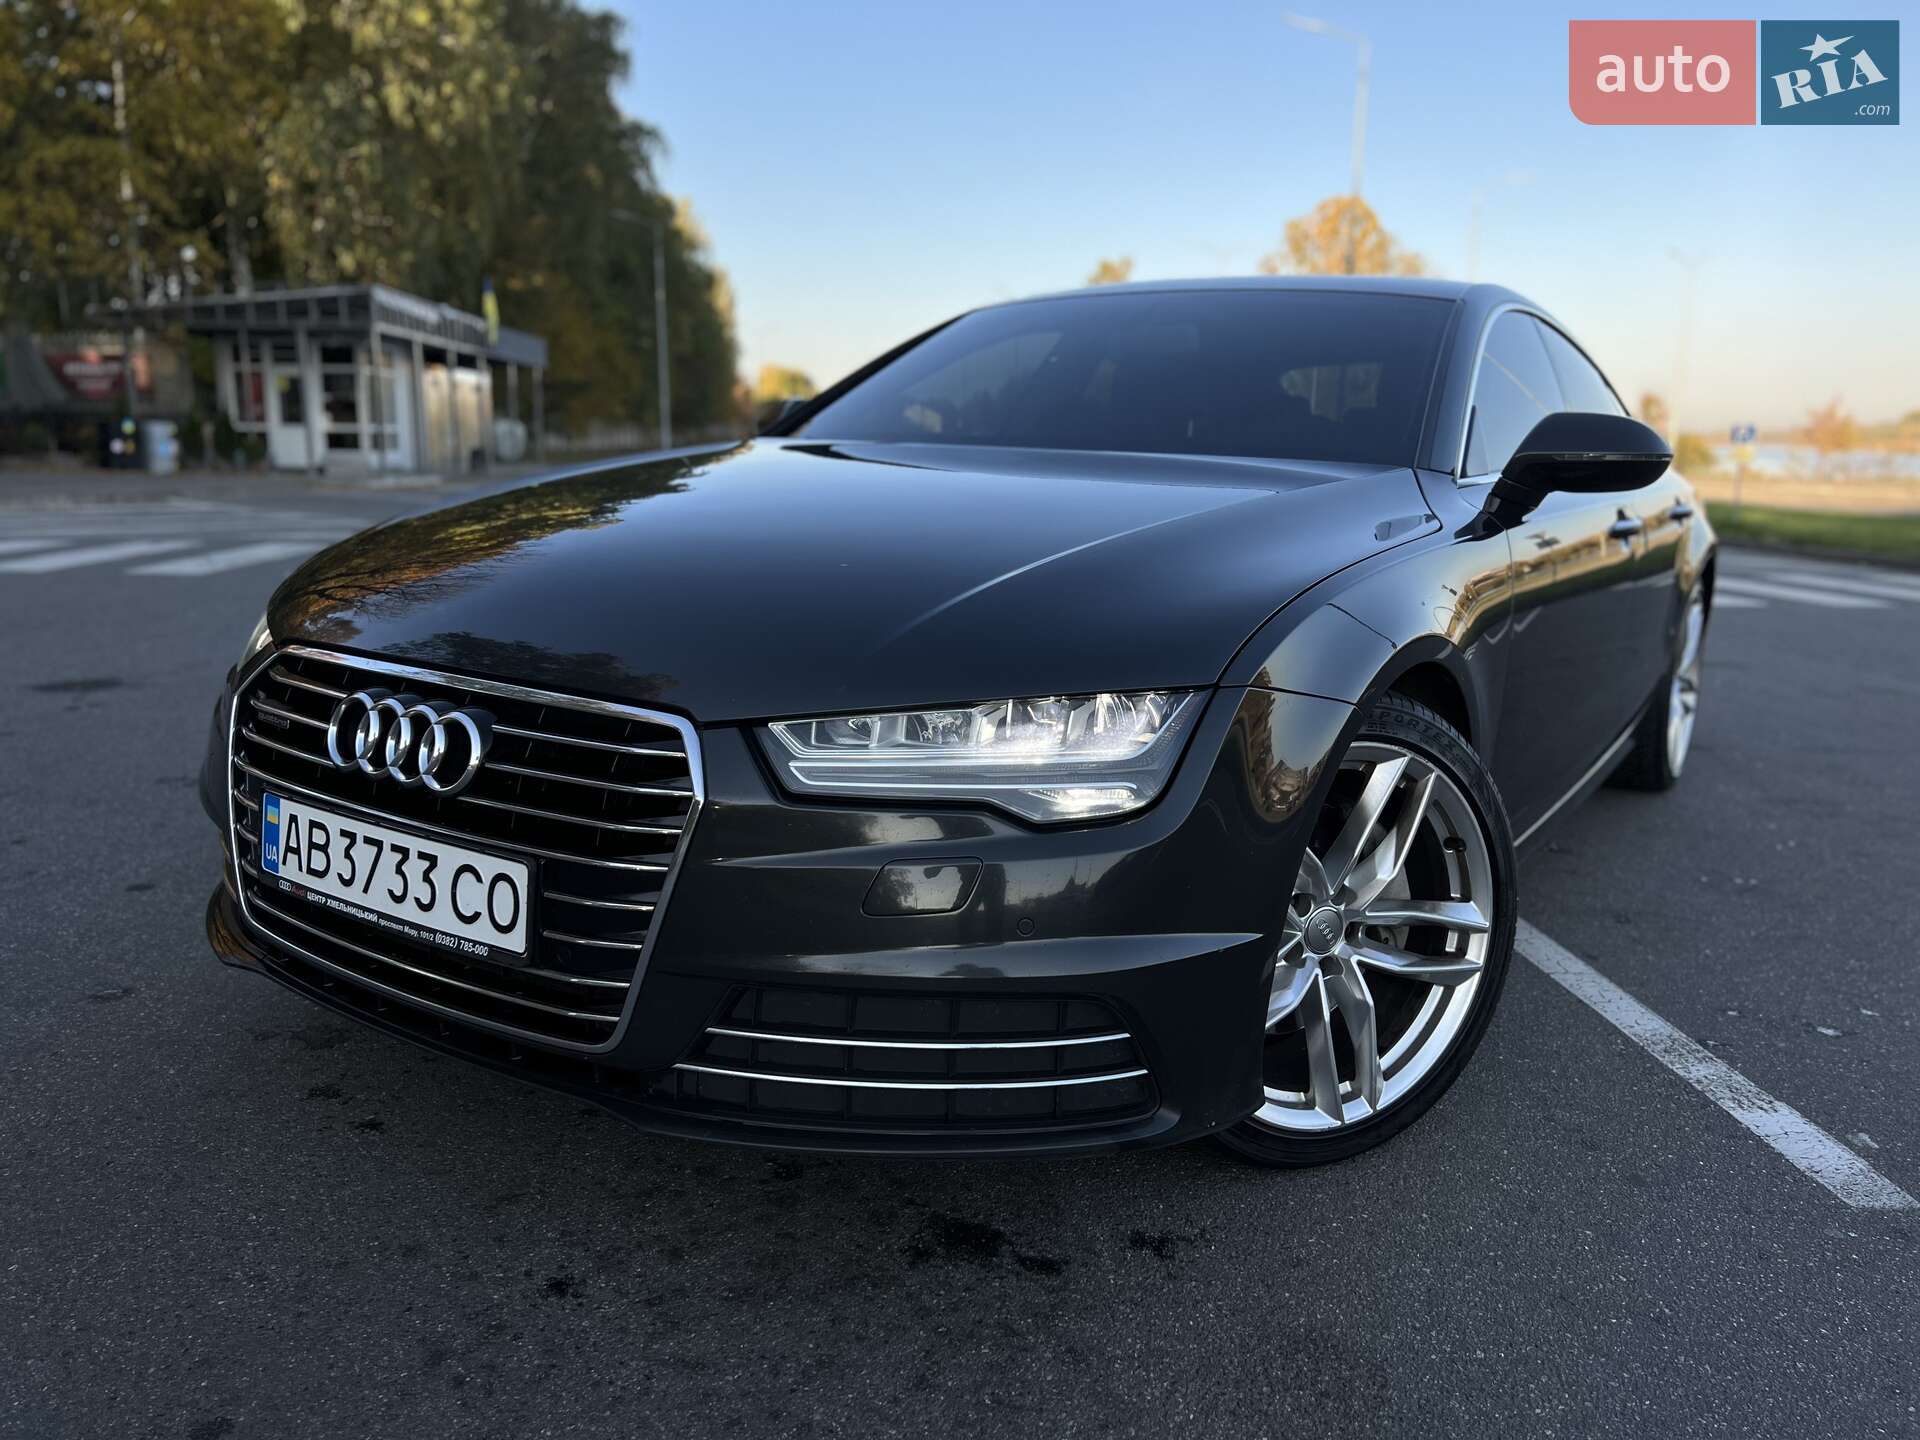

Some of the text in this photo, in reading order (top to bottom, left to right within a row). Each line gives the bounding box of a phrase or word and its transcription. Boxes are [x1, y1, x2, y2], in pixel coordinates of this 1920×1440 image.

[265, 842, 278, 863] UA
[307, 891, 326, 904] ЦЕНТР
[327, 899, 378, 923] ХМЕЛЬНИЦЬКИЙ
